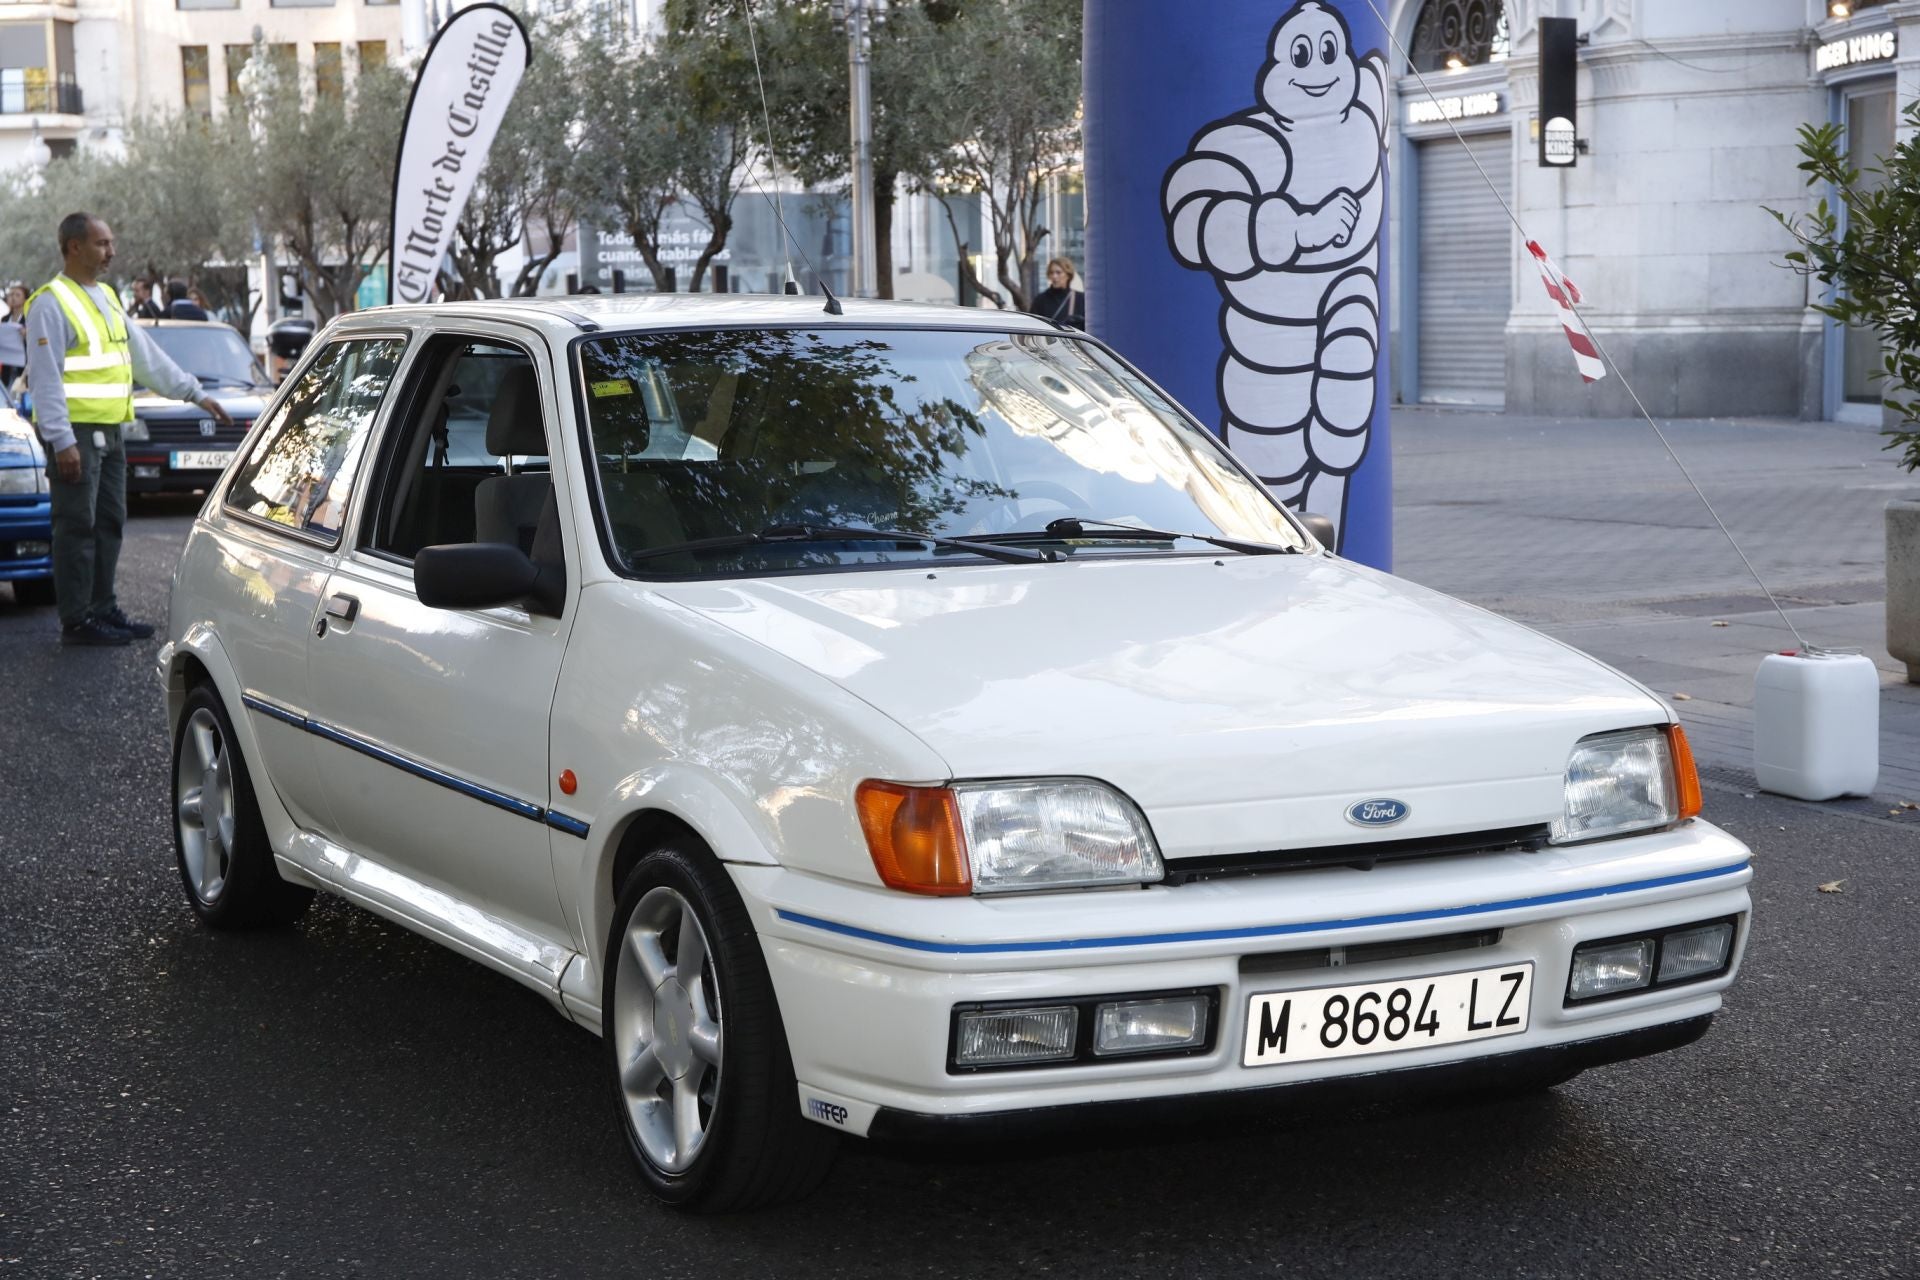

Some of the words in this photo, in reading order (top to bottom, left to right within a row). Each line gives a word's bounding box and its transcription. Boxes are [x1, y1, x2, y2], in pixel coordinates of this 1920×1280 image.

[1850, 31, 1895, 63] KING
[448, 19, 514, 138] Castilla
[432, 141, 467, 174] de
[1545, 141, 1574, 154] KING
[404, 176, 455, 260] Norte
[398, 260, 432, 303] El
[183, 454, 192, 466] P
[1362, 801, 1397, 820] Ford
[1257, 999, 1292, 1056] M
[1319, 984, 1440, 1049] 8684
[1467, 971, 1525, 1032] LZ
